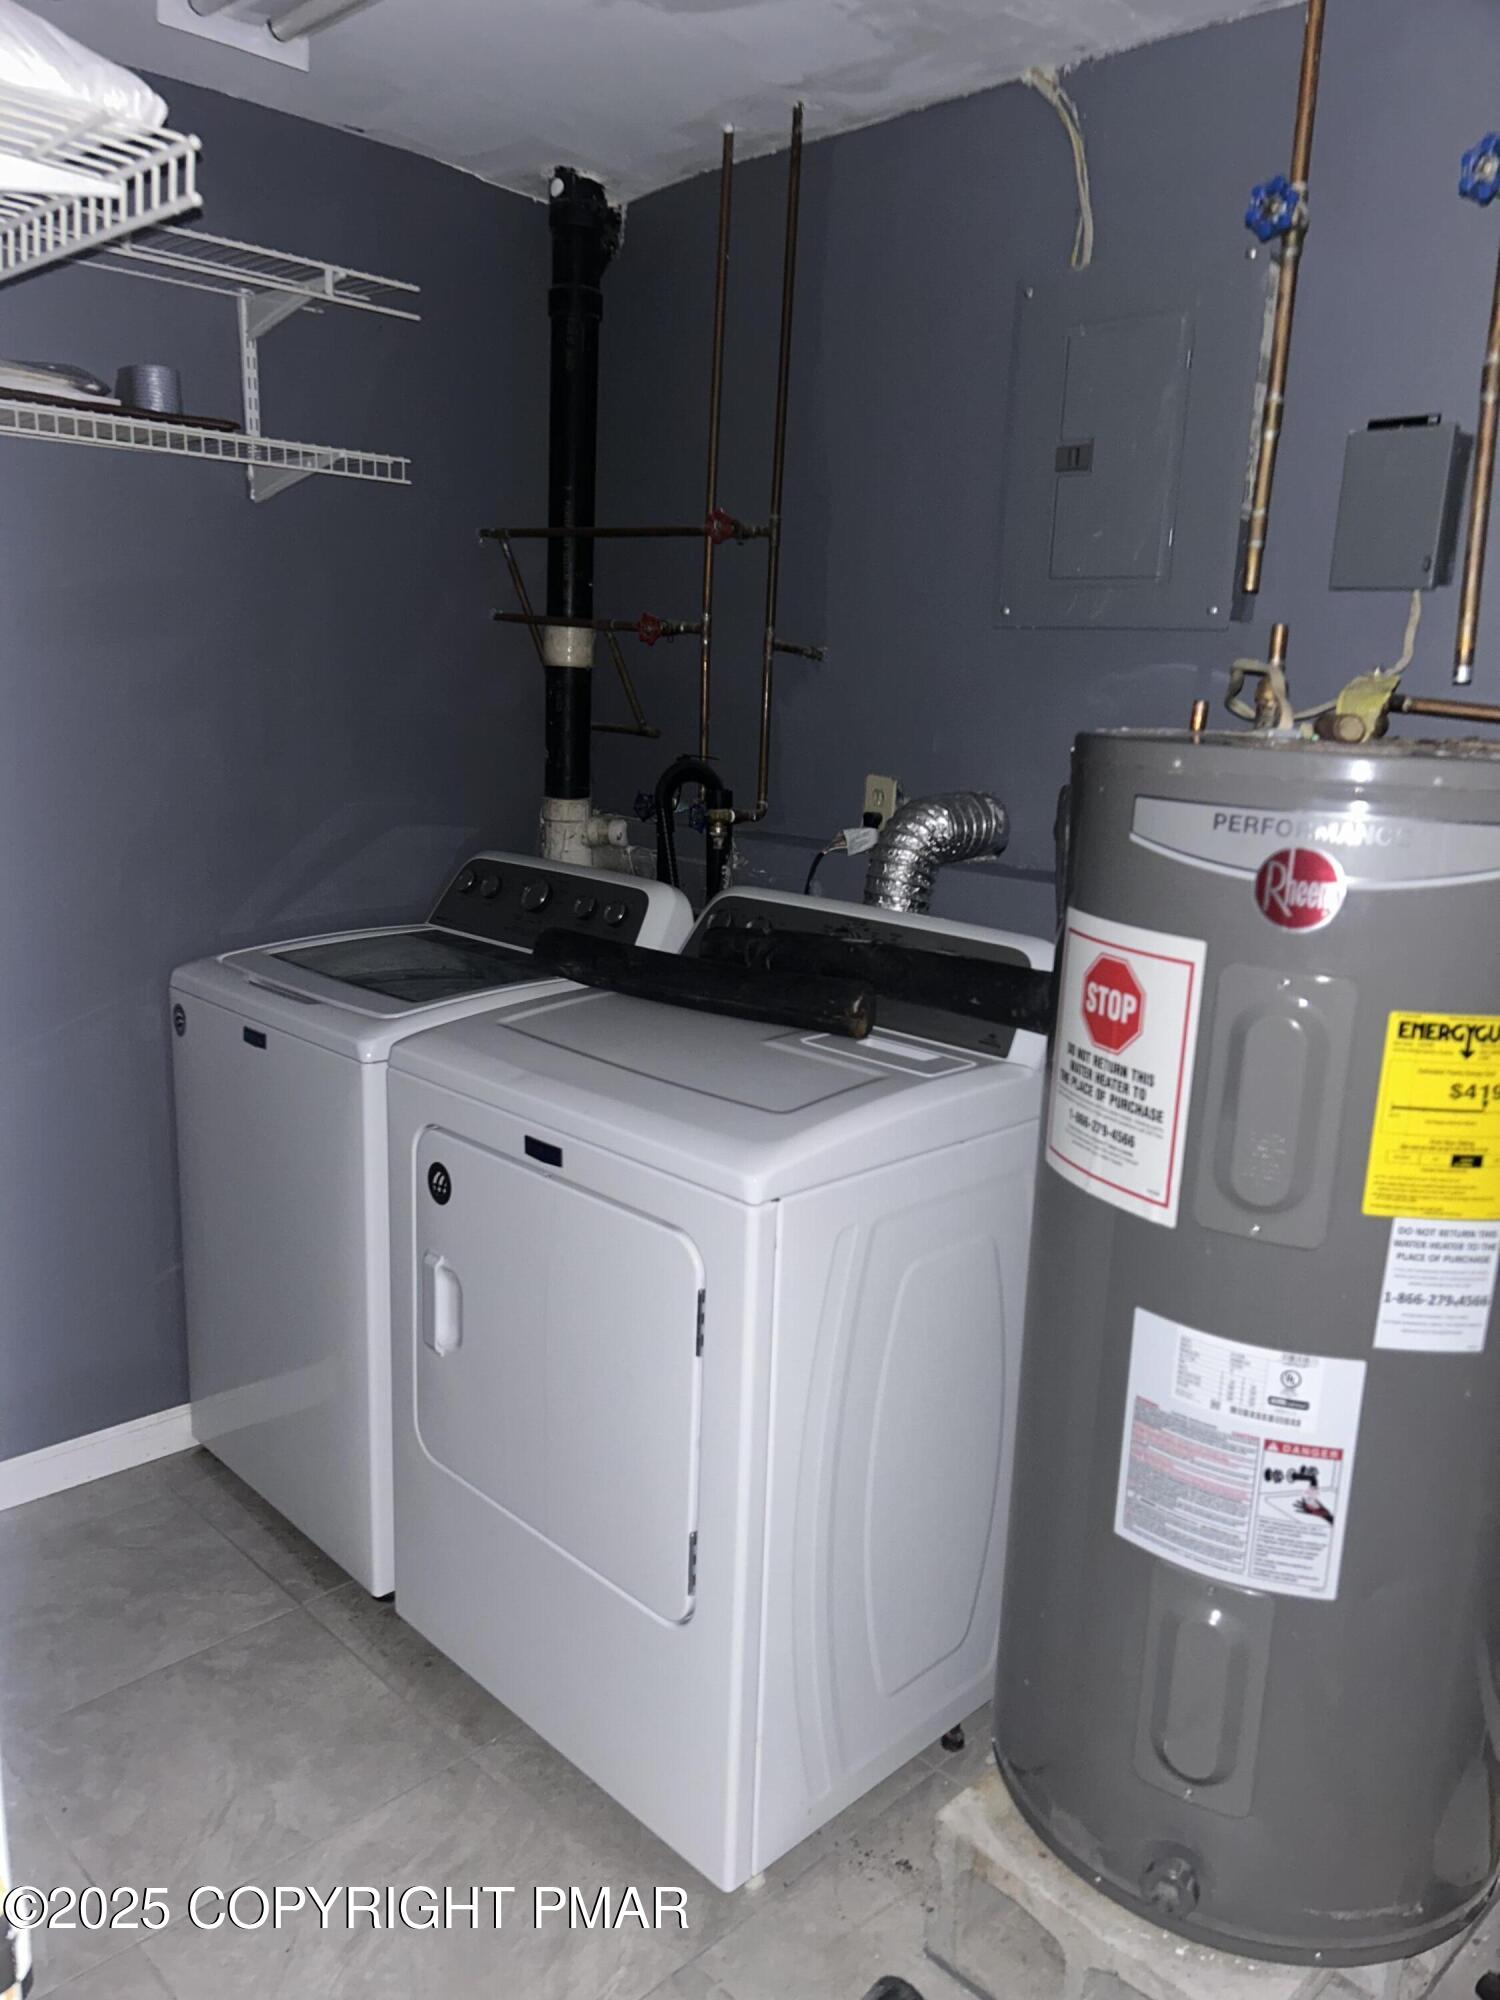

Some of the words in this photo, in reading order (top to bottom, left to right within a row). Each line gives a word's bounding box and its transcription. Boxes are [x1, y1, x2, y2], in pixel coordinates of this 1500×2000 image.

[1085, 981, 1137, 1024] STOP
[1093, 1050, 1128, 1078] RETURN
[1131, 1067, 1155, 1087] THIS
[1095, 1070, 1130, 1095] HEATER
[1133, 1085, 1147, 1101] TO
[1071, 1073, 1094, 1097] PLACE
[1095, 1086, 1106, 1101] OF
[1109, 1093, 1165, 1124] PURCHASE
[1396, 1252, 1425, 1263] PLACE
[1282, 1444, 1340, 1460] DANGER
